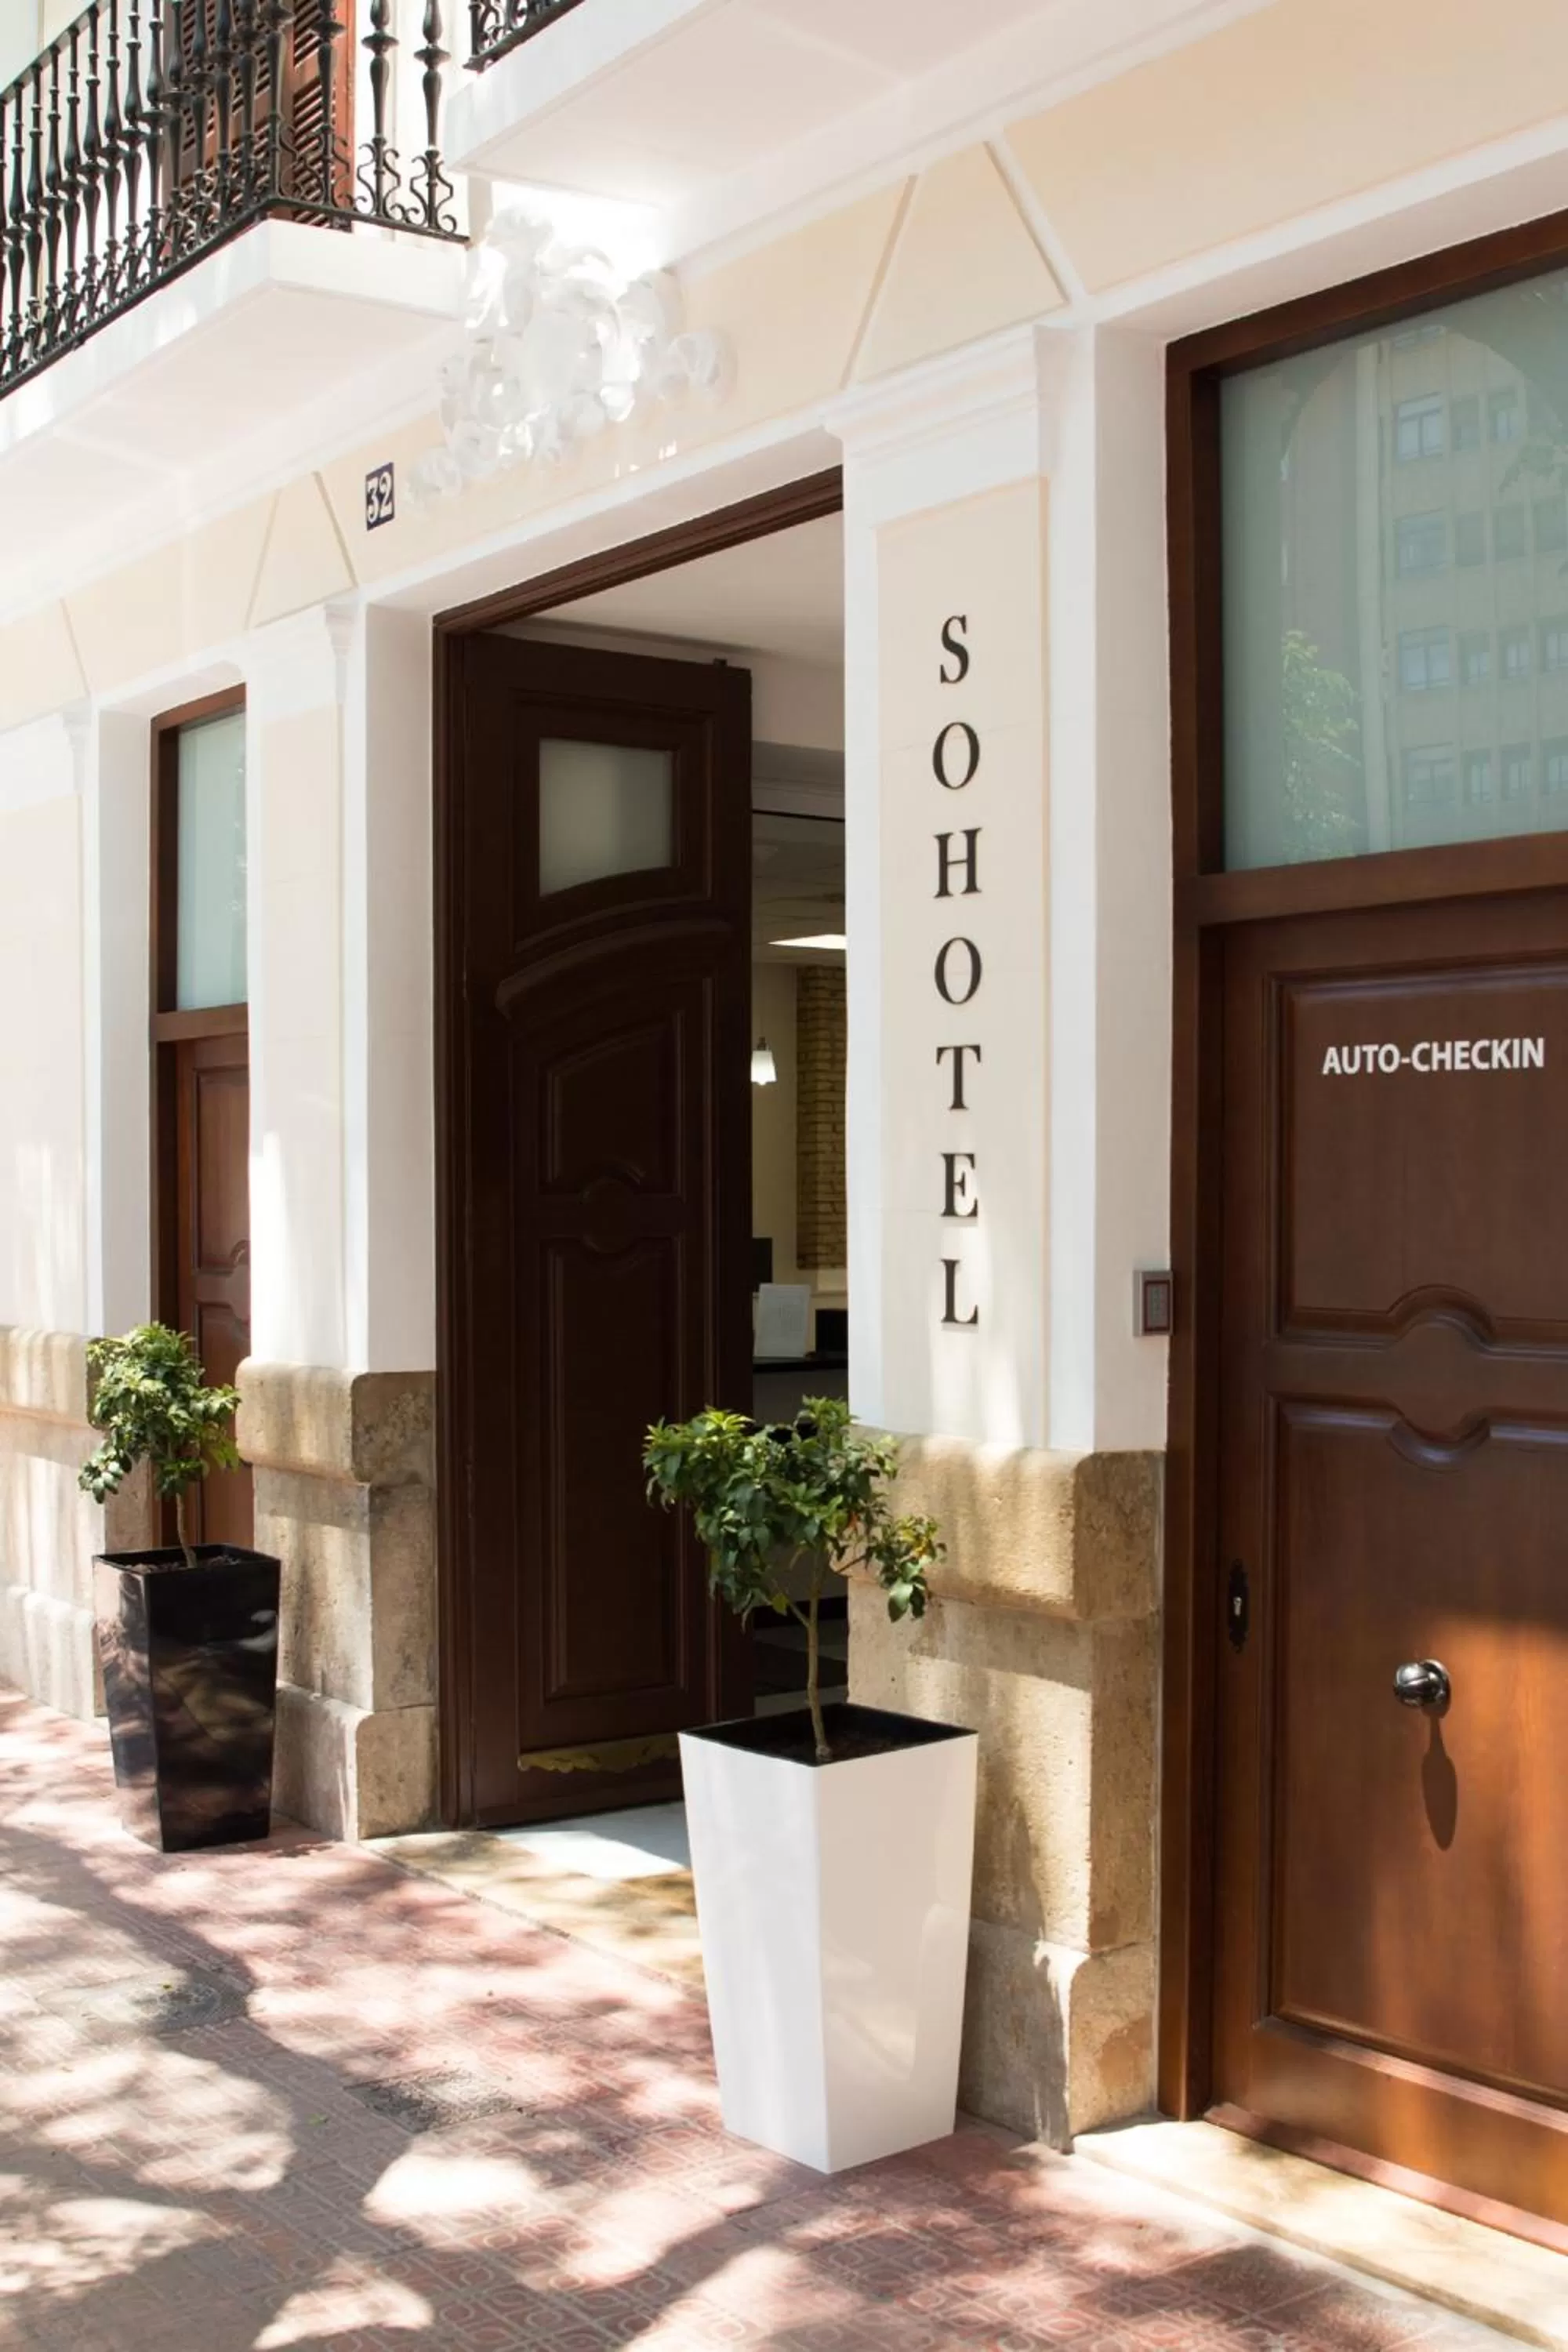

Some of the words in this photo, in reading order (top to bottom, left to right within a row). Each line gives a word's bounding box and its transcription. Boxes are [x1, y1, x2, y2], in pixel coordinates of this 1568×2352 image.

[367, 471, 392, 524] 32
[932, 614, 982, 1326] SOHOTEL
[1322, 1036, 1545, 1076] AUTO-CHECKIN
